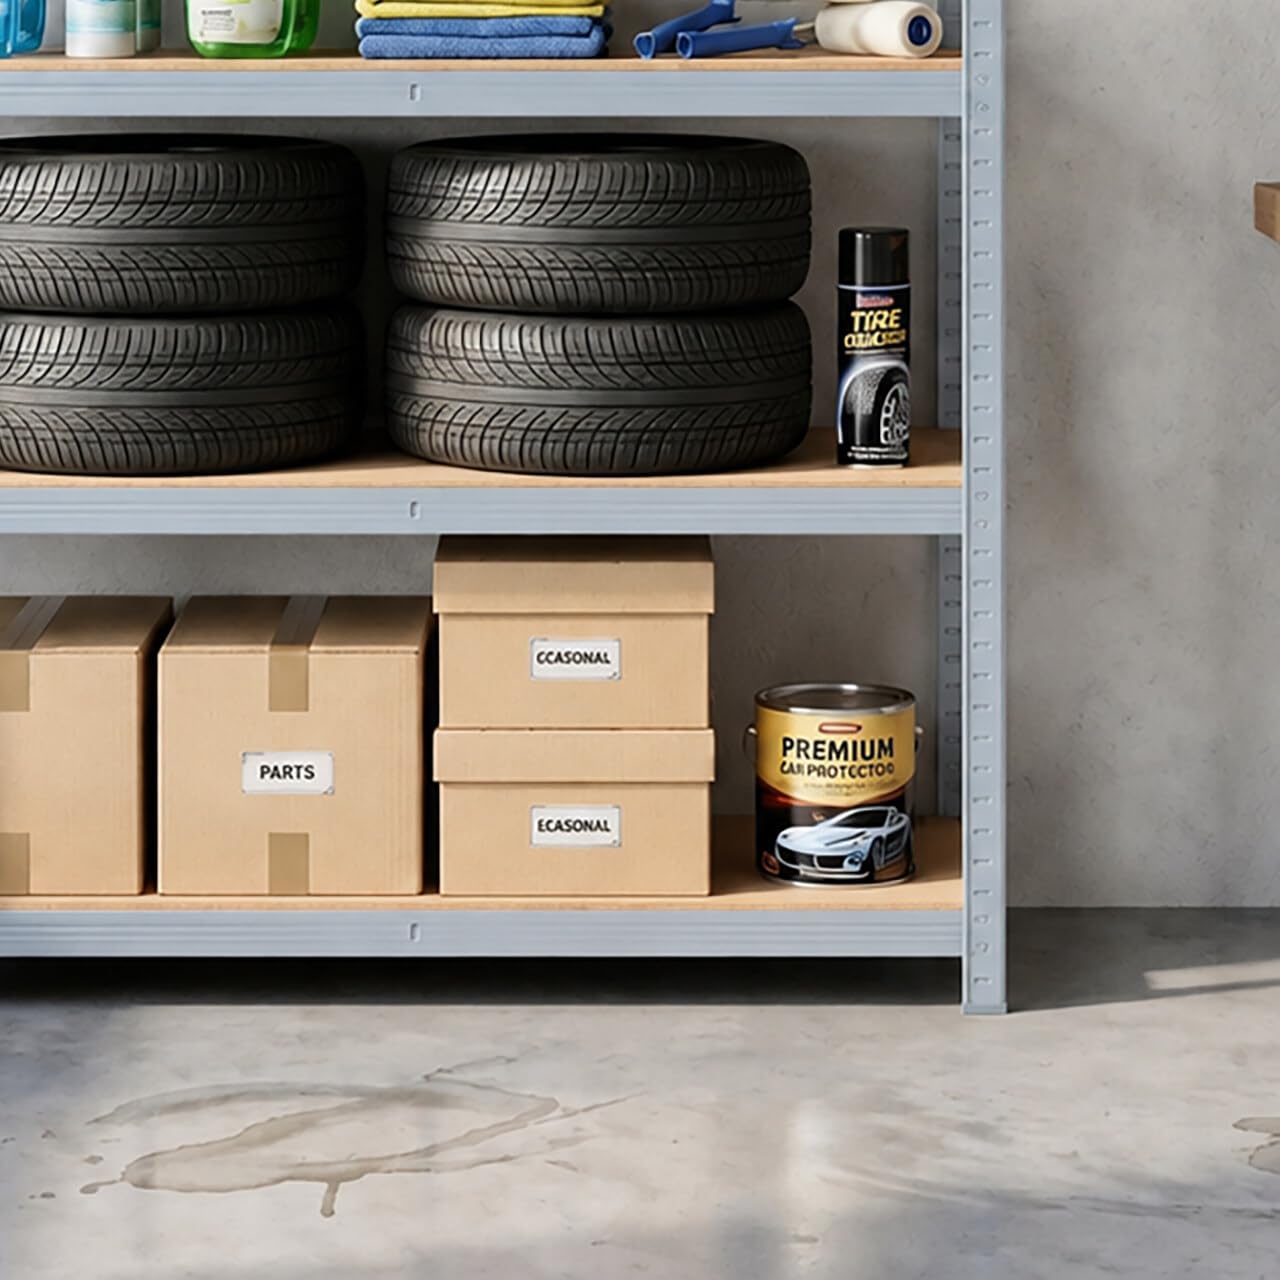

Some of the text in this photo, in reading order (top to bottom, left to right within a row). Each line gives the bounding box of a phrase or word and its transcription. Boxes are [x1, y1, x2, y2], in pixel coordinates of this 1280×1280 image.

[782, 736, 894, 762] PREMIUM
[260, 764, 315, 780] PARTS
[537, 819, 611, 833] ECASONAL
